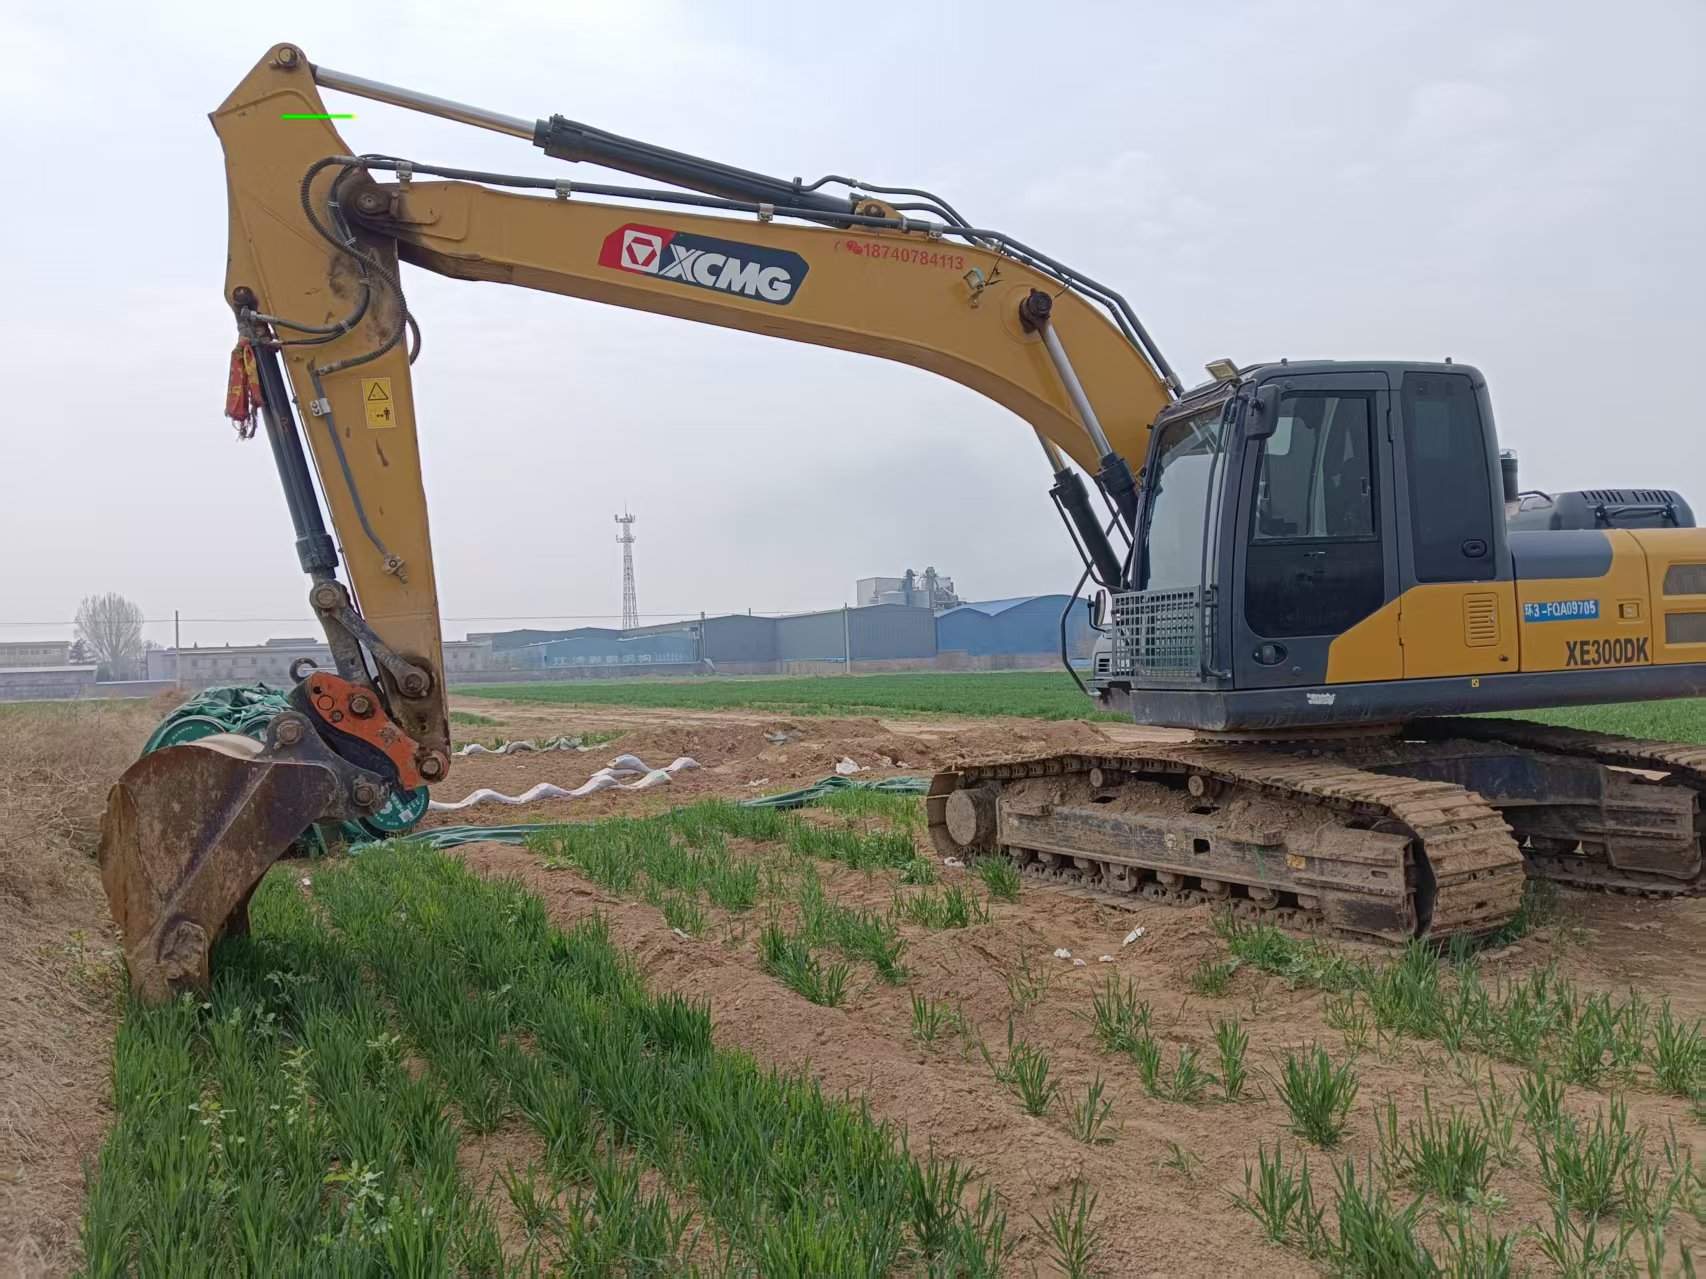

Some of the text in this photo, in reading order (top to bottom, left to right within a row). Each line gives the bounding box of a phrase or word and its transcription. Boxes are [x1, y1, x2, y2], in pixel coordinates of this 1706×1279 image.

[864, 243, 965, 271] 18740784113
[659, 243, 792, 303] XCMG
[1566, 637, 1648, 667] XE300DK
